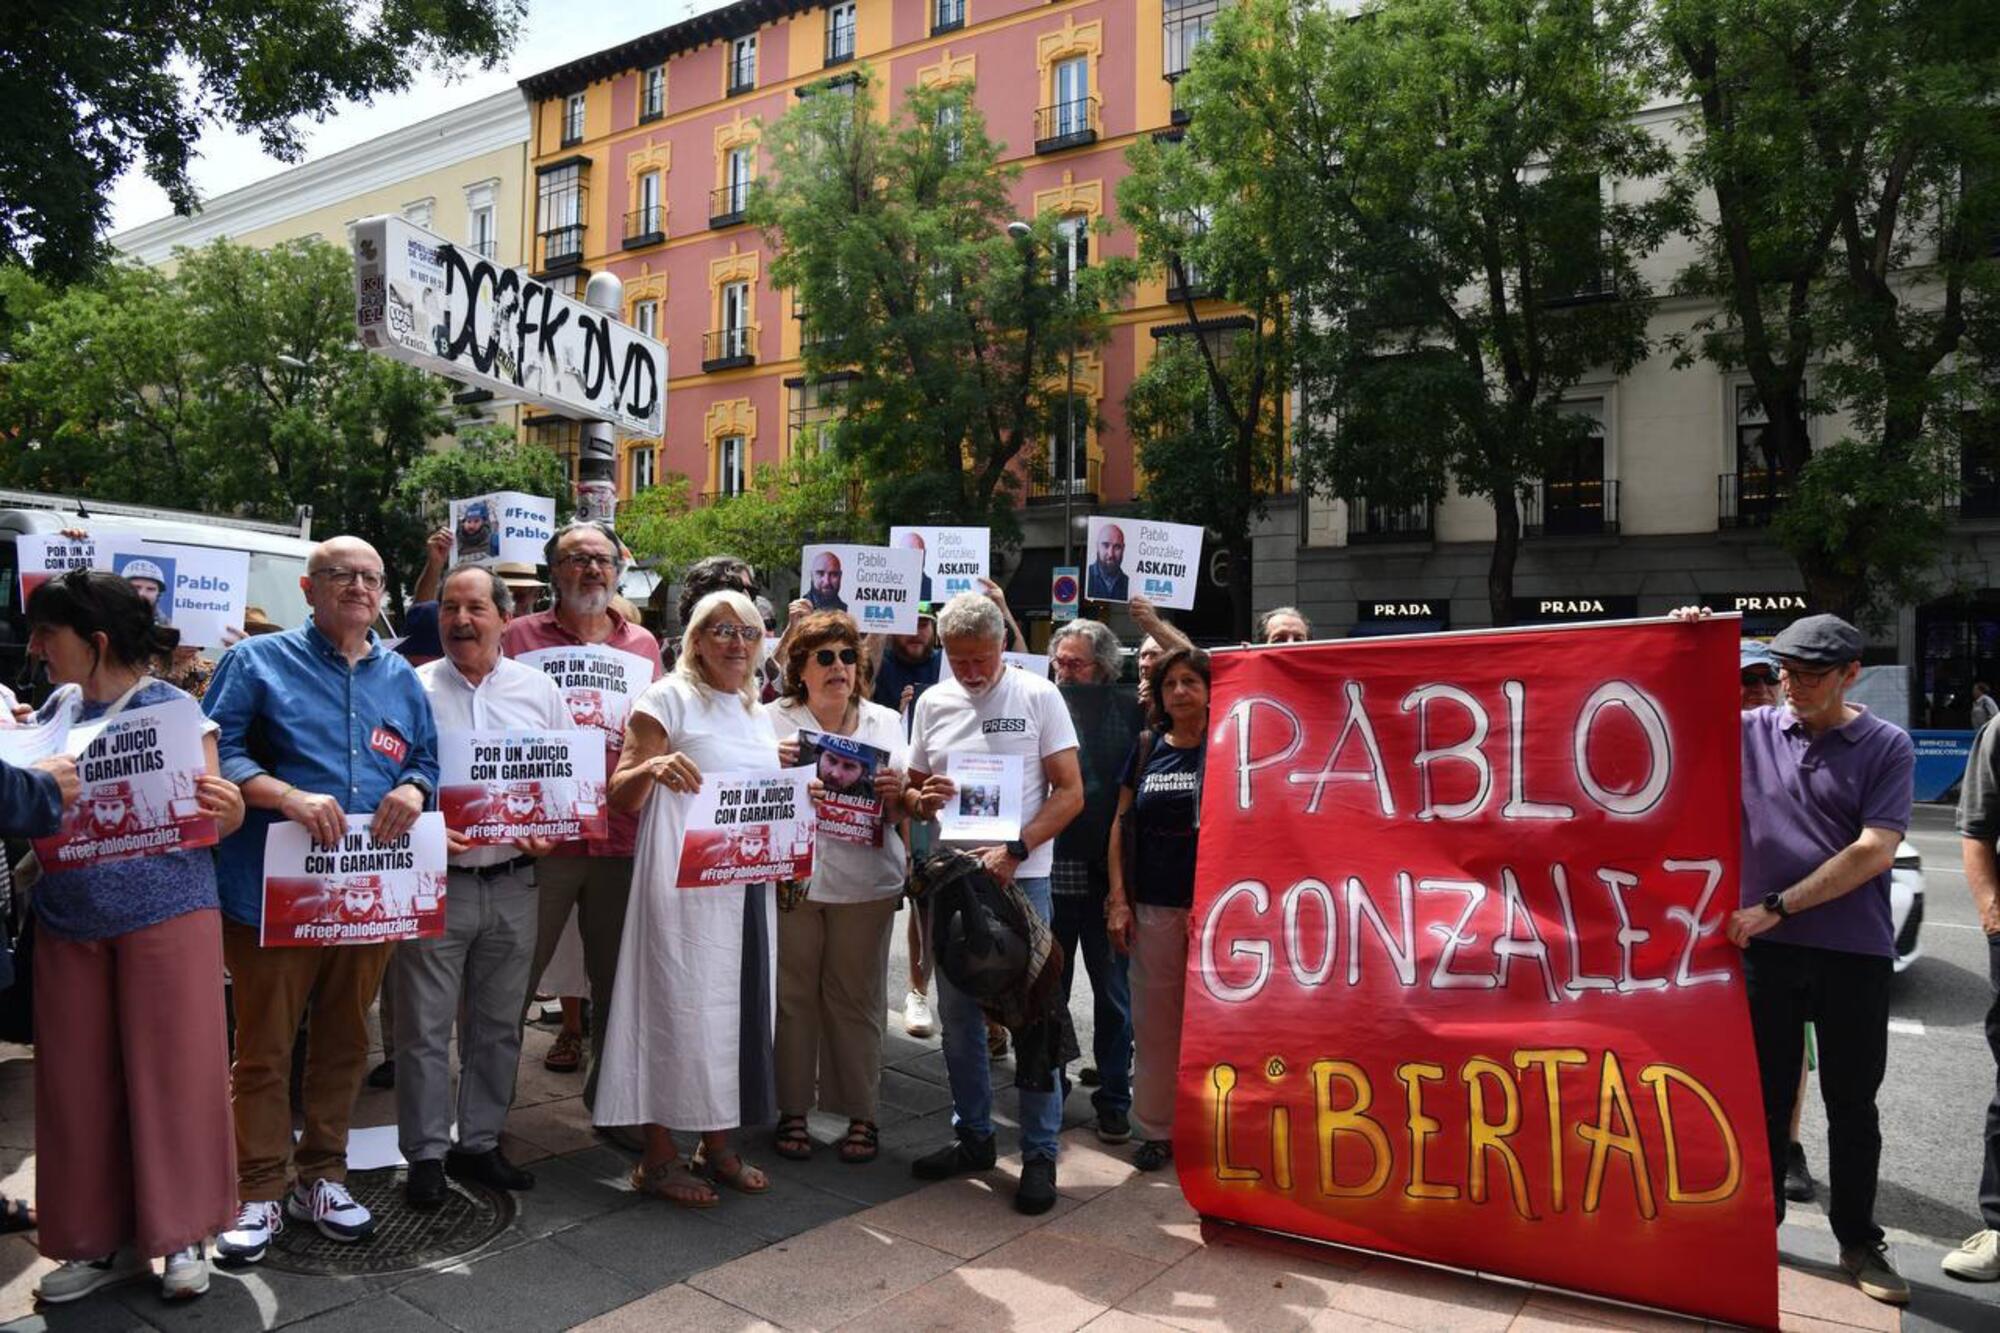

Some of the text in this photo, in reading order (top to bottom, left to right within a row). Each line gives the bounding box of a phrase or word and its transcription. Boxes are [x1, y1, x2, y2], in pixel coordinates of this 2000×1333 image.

[578, 315, 658, 419] DVD
[505, 507, 547, 522] #Free
[505, 526, 550, 540] Pablo
[939, 532, 962, 545] Pablo
[1140, 526, 1168, 541] Pablo
[46, 545, 67, 557] POR
[69, 545, 82, 556] UN
[857, 552, 886, 567] Pablo
[1138, 541, 1184, 560] González
[44, 558, 65, 569] CON
[937, 563, 979, 575] ASKATU!
[1136, 560, 1186, 577] ASKATU!
[176, 574, 230, 593] Pablo
[856, 567, 904, 584] González
[855, 587, 907, 602] ASKATU!
[1735, 597, 1807, 610] PRADA
[174, 599, 230, 612] Libertad
[864, 605, 894, 619] ELA
[1374, 604, 1432, 616] PRADA
[1540, 600, 1604, 613] PRADA
[543, 659, 625, 678] POR UN JUICIO
[565, 674, 628, 694] GARANTÍAS
[983, 719, 1025, 733] PRESS
[88, 728, 157, 758] UN JUICIO
[371, 729, 401, 756] UGT
[1214, 679, 1671, 821] PABLO
[474, 745, 568, 762] POR UN JUICIO
[85, 750, 164, 783] GARANTÍAS
[471, 761, 573, 780] CON GARANTÍAS
[720, 786, 794, 806] POR UN JUICIO
[714, 804, 796, 825] CON GARANTÍAS
[465, 819, 581, 838] #FreePabloGonzález
[58, 827, 182, 862] #FreePabloGonzález
[344, 834, 362, 852] UN
[305, 852, 414, 874] CON GARANTÍAS
[700, 861, 795, 881] #FreePabloGonzález
[294, 919, 419, 939] #FreePabloGonzález
[1200, 858, 1733, 1004] GONZALEZ
